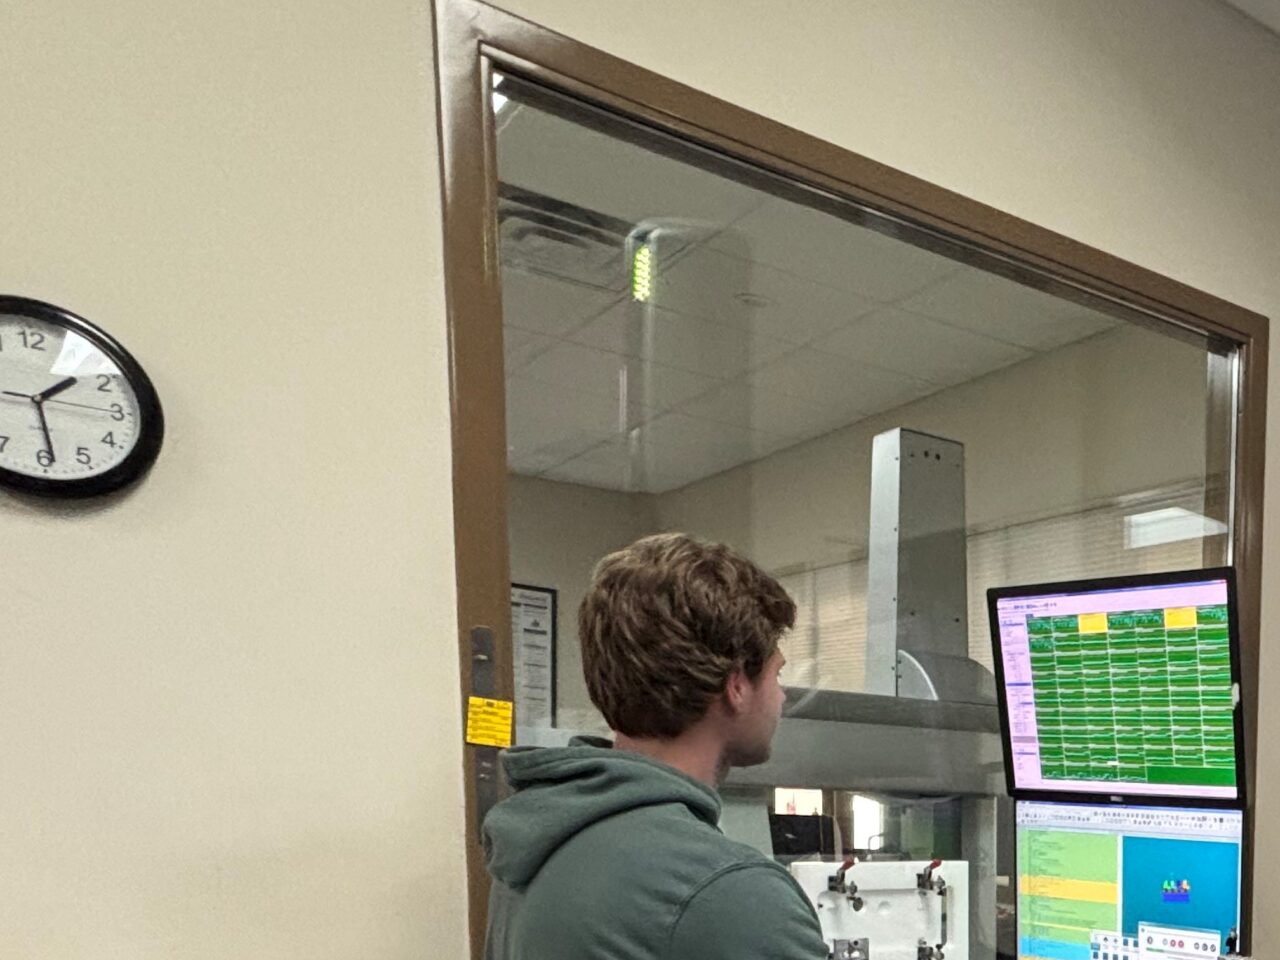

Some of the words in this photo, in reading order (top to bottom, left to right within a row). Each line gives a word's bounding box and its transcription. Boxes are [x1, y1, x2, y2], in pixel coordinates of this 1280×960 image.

[17, 330, 47, 351] 12
[96, 374, 112, 392] 2
[110, 403, 125, 421] 3
[101, 431, 117, 448] 4
[36, 450, 53, 467] 6
[76, 447, 91, 465] 5
